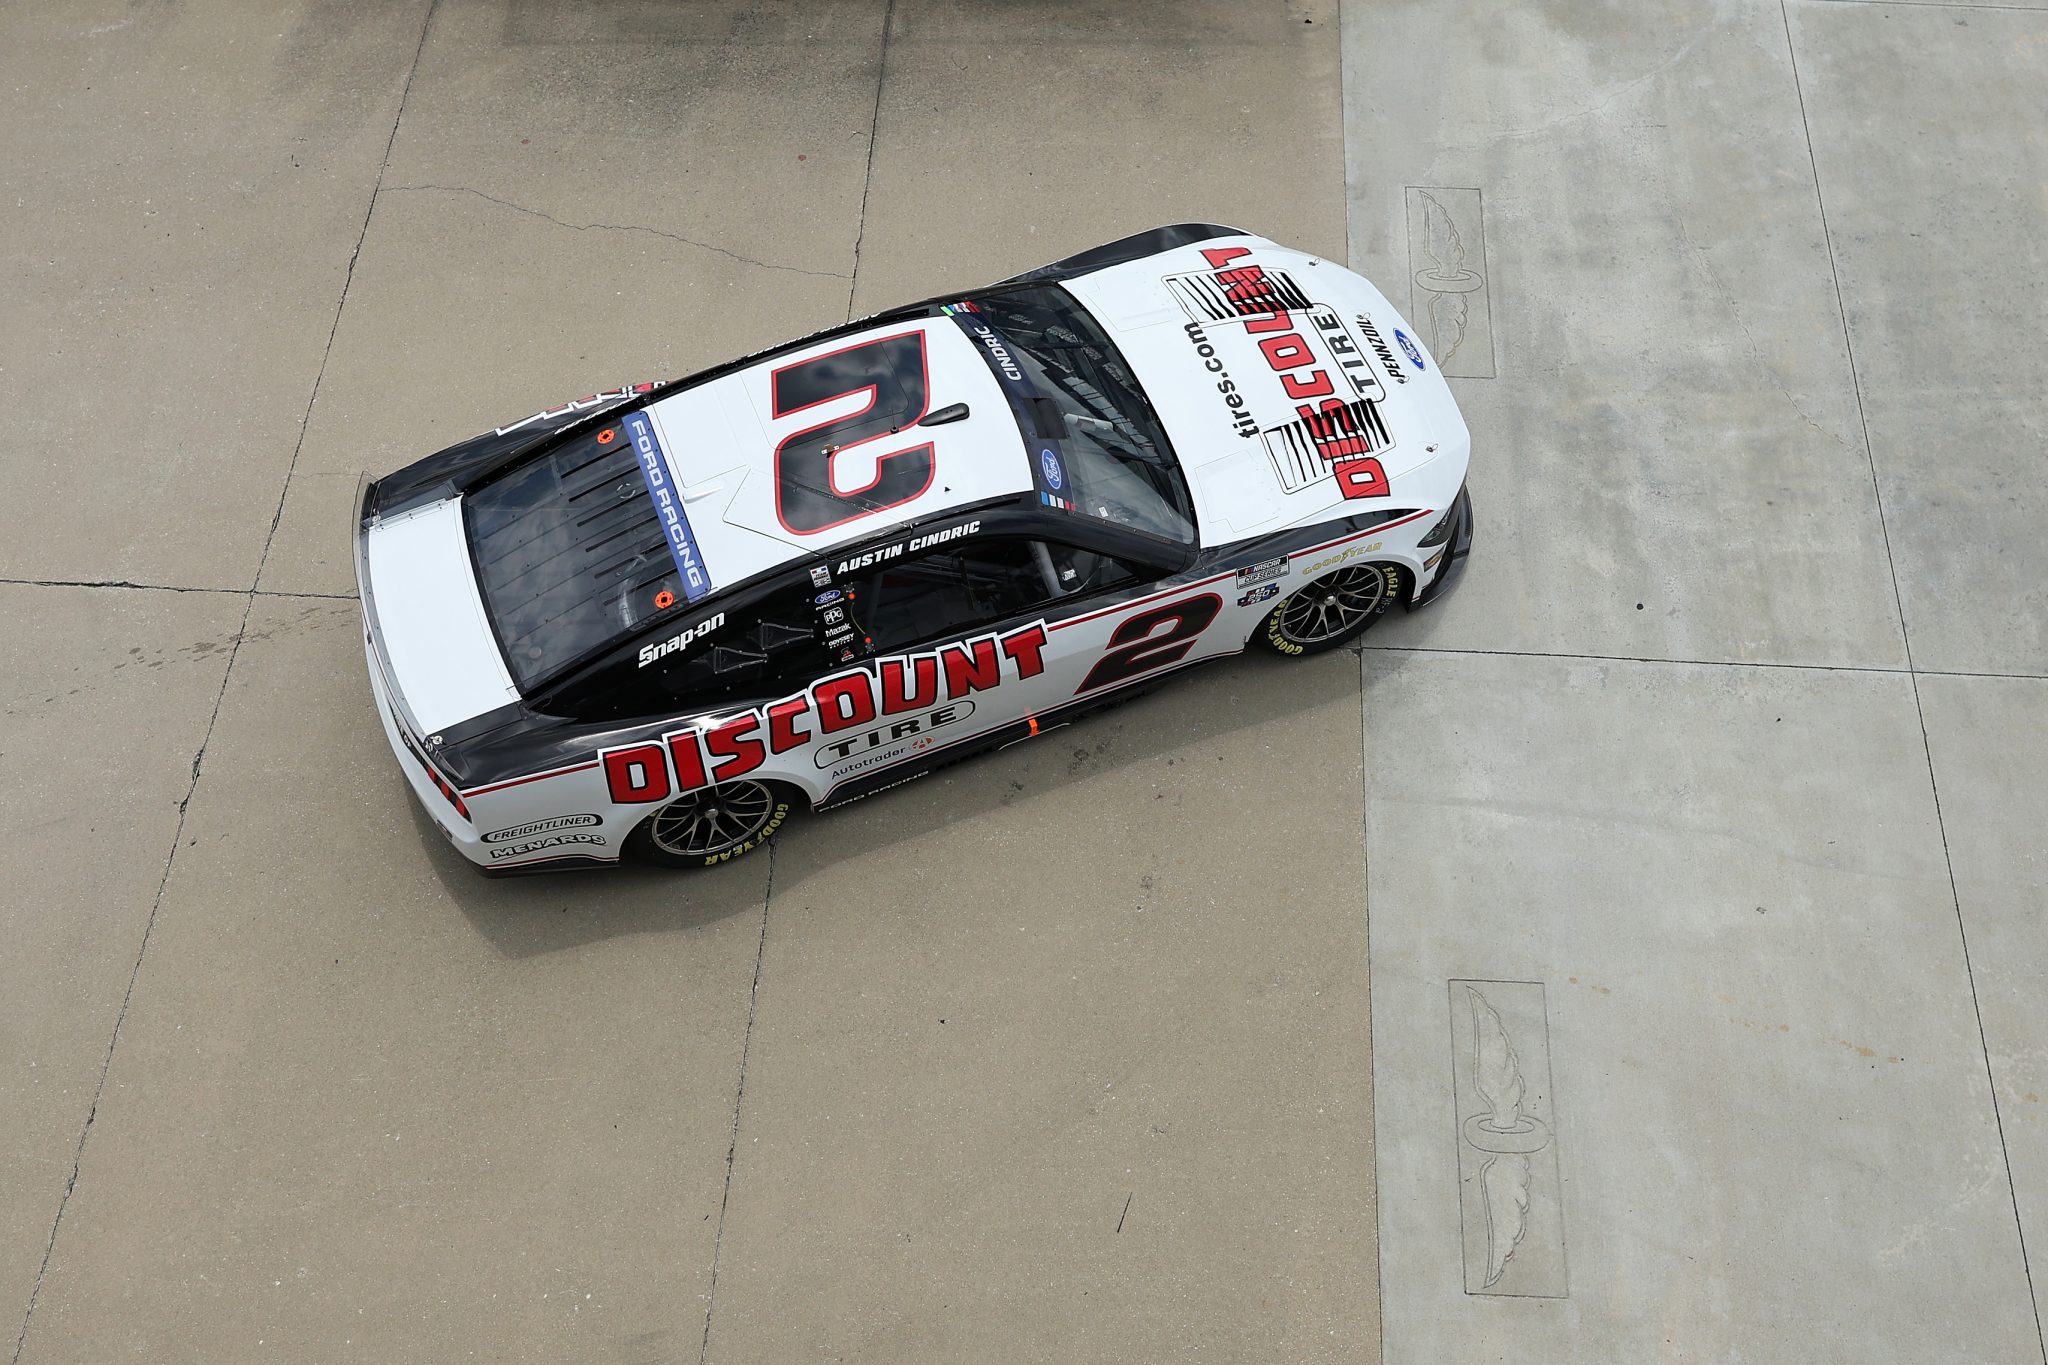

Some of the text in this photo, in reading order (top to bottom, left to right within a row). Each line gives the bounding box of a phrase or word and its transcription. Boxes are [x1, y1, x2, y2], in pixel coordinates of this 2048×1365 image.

[974, 326, 1022, 381] CINDRIC
[1200, 247, 1391, 500] DISCOUNT
[1321, 313, 1377, 395] TIRE
[1356, 320, 1405, 378] PENNZOIL
[1397, 333, 1423, 366] Ford
[1184, 322, 1259, 438] tires.com
[771, 329, 936, 536] 2
[1043, 454, 1061, 484] Ford
[631, 419, 703, 588] FORD RACING
[837, 520, 981, 575] AUSTIN CINDRIC
[1253, 559, 1281, 572] NASCAR
[1302, 541, 1382, 575] GOODYEAR
[818, 591, 838, 603] Ford
[1382, 566, 1398, 597] EAGLE
[638, 612, 724, 668] Snap-on
[825, 623, 851, 637] Mazak
[826, 610, 842, 622] PPG
[1073, 592, 1223, 695] 2
[602, 622, 1048, 805] DISCOUNT
[828, 707, 956, 758] TIRE
[832, 747, 906, 779] Autotrader
[490, 833, 607, 859] MENARDS
[493, 816, 592, 841] FREIGHTLINER
[705, 803, 789, 866] GOODYEAR
